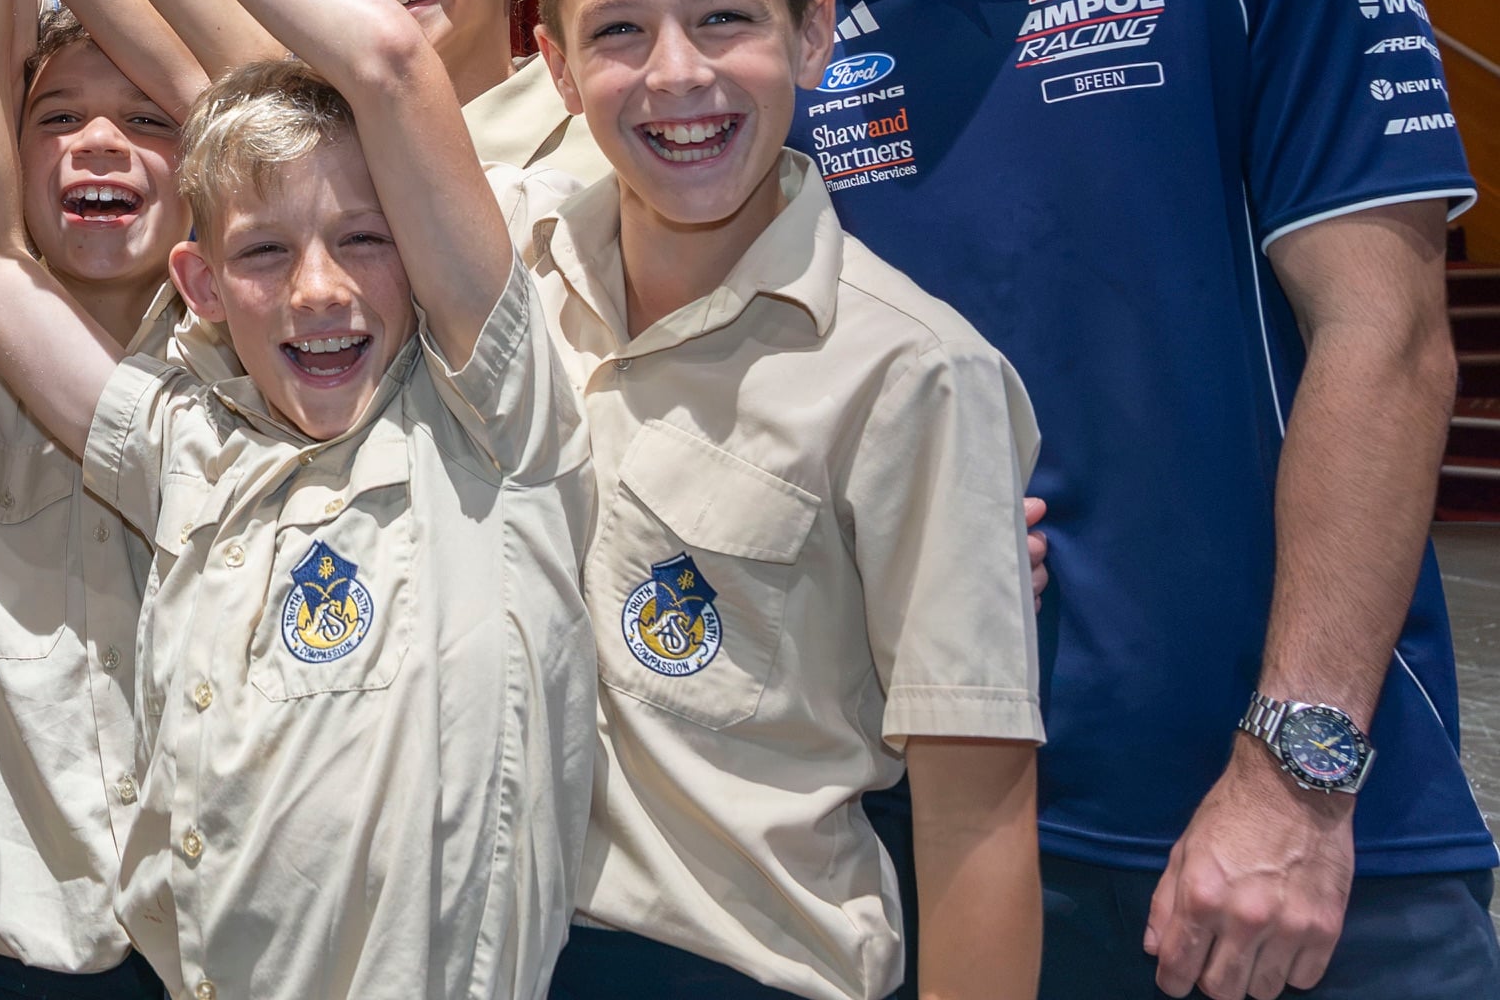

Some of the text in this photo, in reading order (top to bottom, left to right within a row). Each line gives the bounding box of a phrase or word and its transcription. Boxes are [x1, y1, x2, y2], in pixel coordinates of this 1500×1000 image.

[1018, 15, 1159, 61] RACING
[827, 59, 879, 88] Ford
[1074, 70, 1126, 92] BFEEN
[1395, 79, 1430, 94] NEW
[808, 85, 905, 117] RACING
[817, 140, 914, 176] Partners
[826, 165, 918, 193] Financial Services
[285, 592, 303, 628] TRUTH
[351, 588, 371, 616] FAITH
[627, 585, 654, 615] TRUTH
[703, 611, 718, 643] FAITH
[299, 641, 354, 660] COMPASSION
[633, 642, 691, 674] COMPASSION
